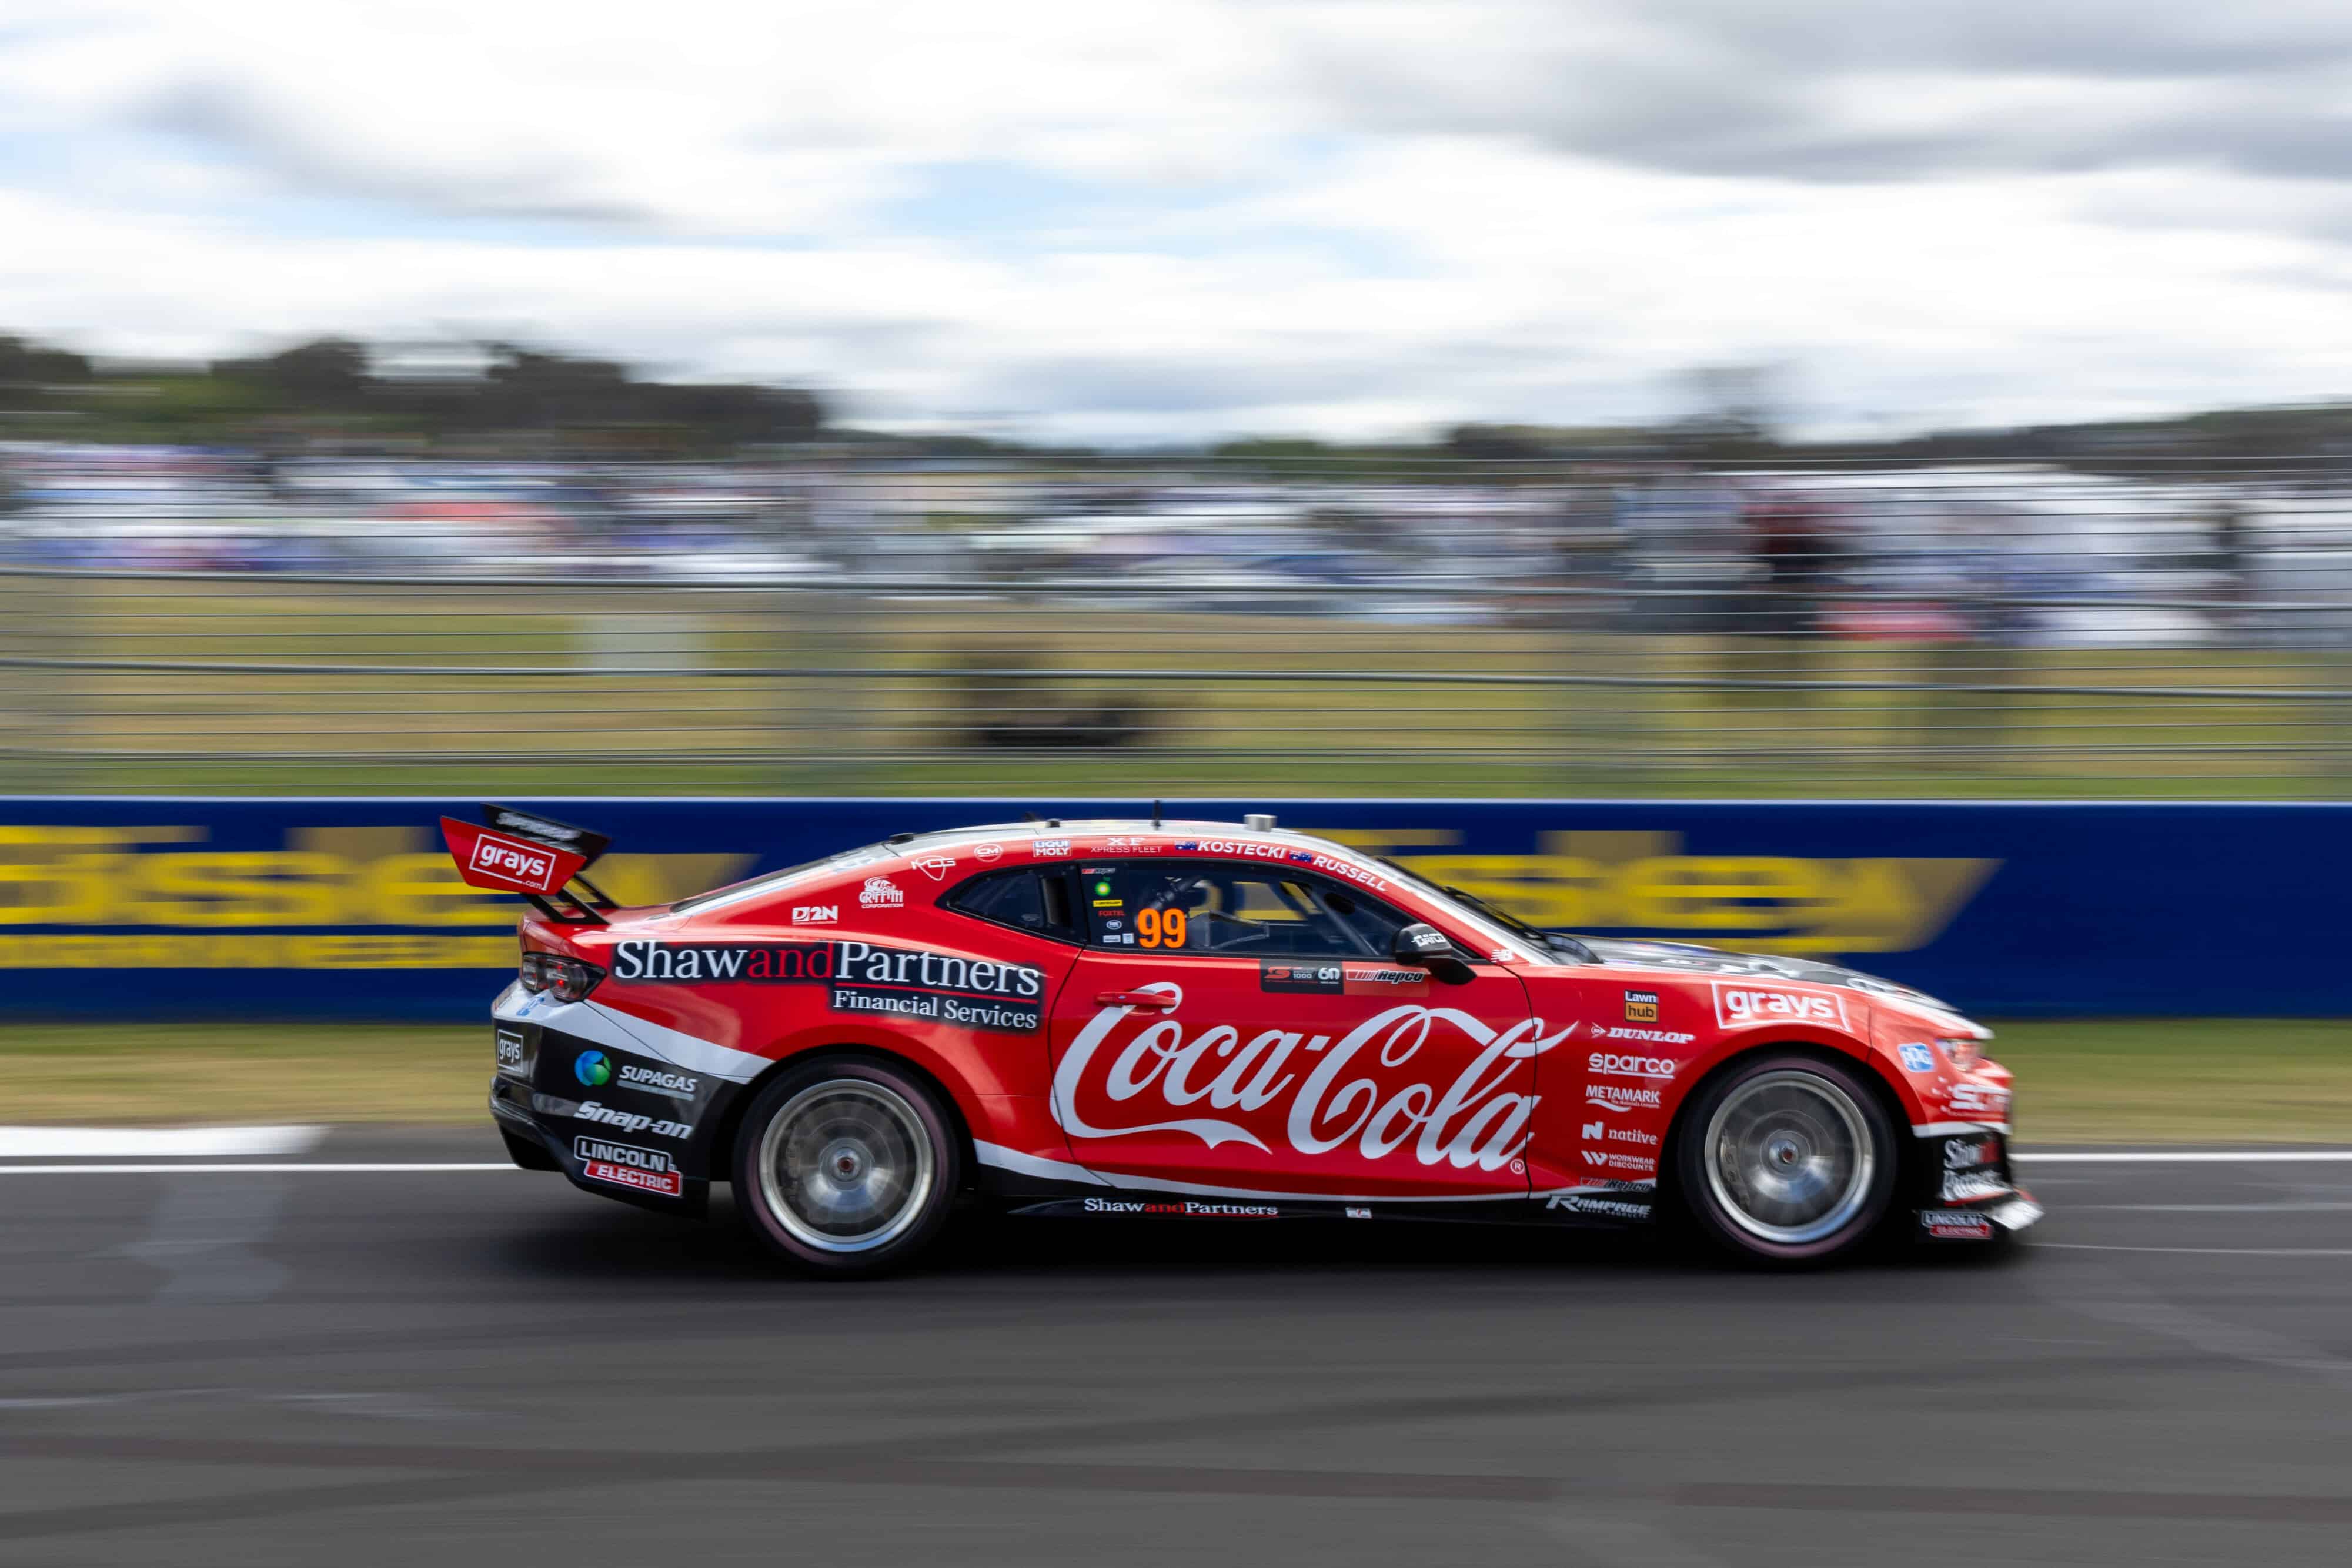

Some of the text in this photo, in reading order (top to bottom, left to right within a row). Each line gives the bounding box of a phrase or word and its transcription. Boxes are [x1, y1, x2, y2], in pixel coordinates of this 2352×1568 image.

[479, 844, 546, 877] grays
[1035, 847, 1070, 856] MOLY
[1197, 840, 1287, 860] KOSTECKI
[1312, 855, 1388, 892] RUSSELL
[1137, 907, 1187, 949] 99
[1376, 969, 1425, 984] Repco
[833, 990, 1038, 1029] Financial Services
[1625, 990, 1658, 1003] Lawn
[1726, 990, 1835, 1019] grays
[1628, 1004, 1655, 1018] hub
[1606, 1027, 1696, 1044] DUNLOP
[499, 1039, 520, 1064] grays
[1589, 1052, 1675, 1075] sparco
[619, 1065, 699, 1092] SUPAGAS
[1050, 982, 1579, 1172] Coca-Cola
[1585, 1084, 1661, 1104] METAMARK
[573, 1100, 694, 1139] Snap-on
[580, 1141, 666, 1172] LINCOLN
[1608, 1153, 1655, 1164] WORKWEAR
[596, 1164, 674, 1191] ELECTRIC
